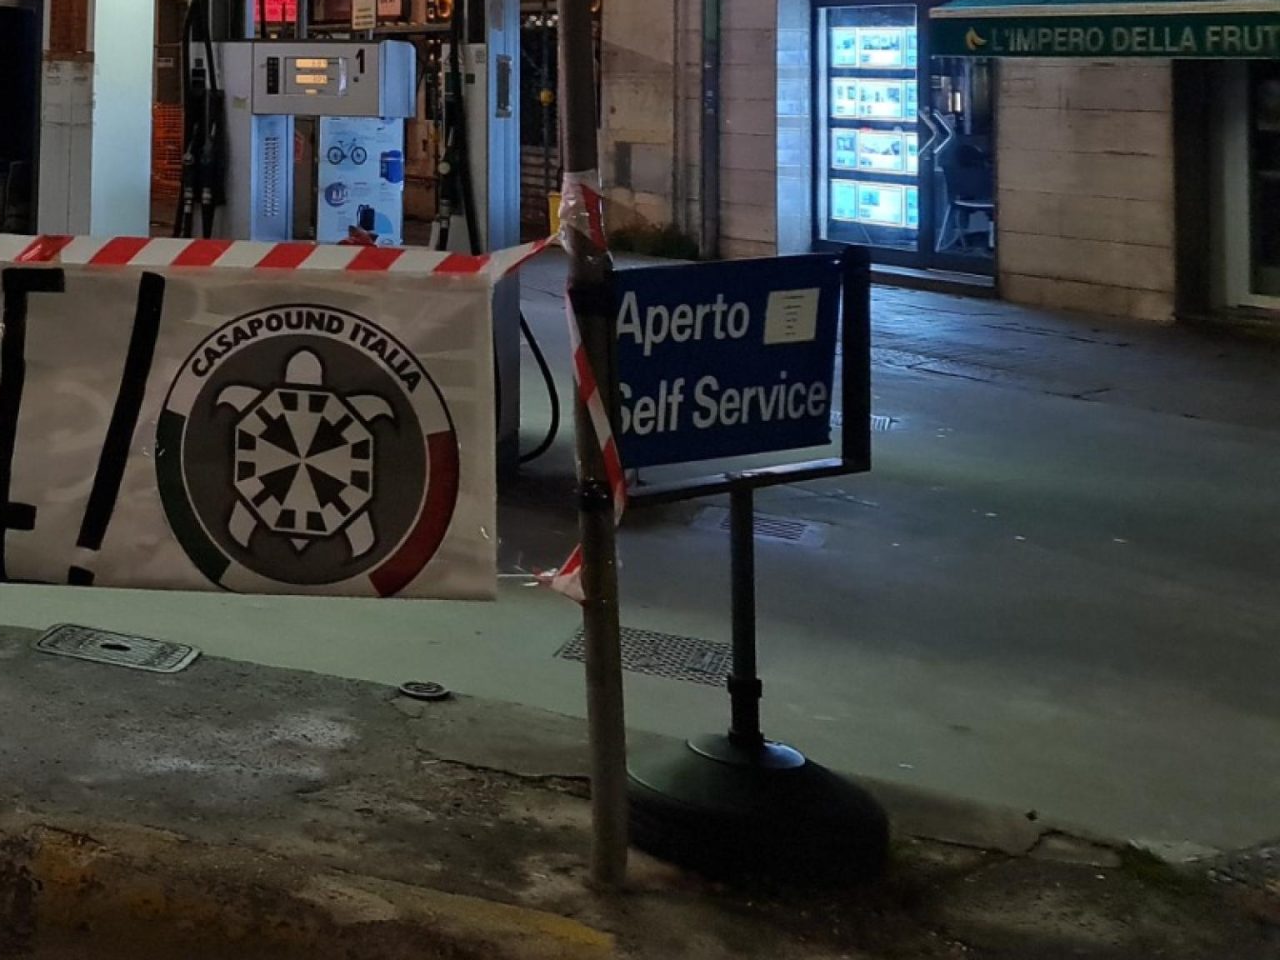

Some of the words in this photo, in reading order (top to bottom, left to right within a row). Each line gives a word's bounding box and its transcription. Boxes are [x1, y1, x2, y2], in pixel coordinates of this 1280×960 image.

[355, 48, 365, 74] 1
[991, 25, 1105, 52] L'IMPERO
[1111, 25, 1195, 51] DELLA
[192, 310, 345, 378] CASAPOUND
[349, 321, 425, 393] ITALIA
[616, 290, 751, 356] Aperto
[693, 370, 828, 430] Service
